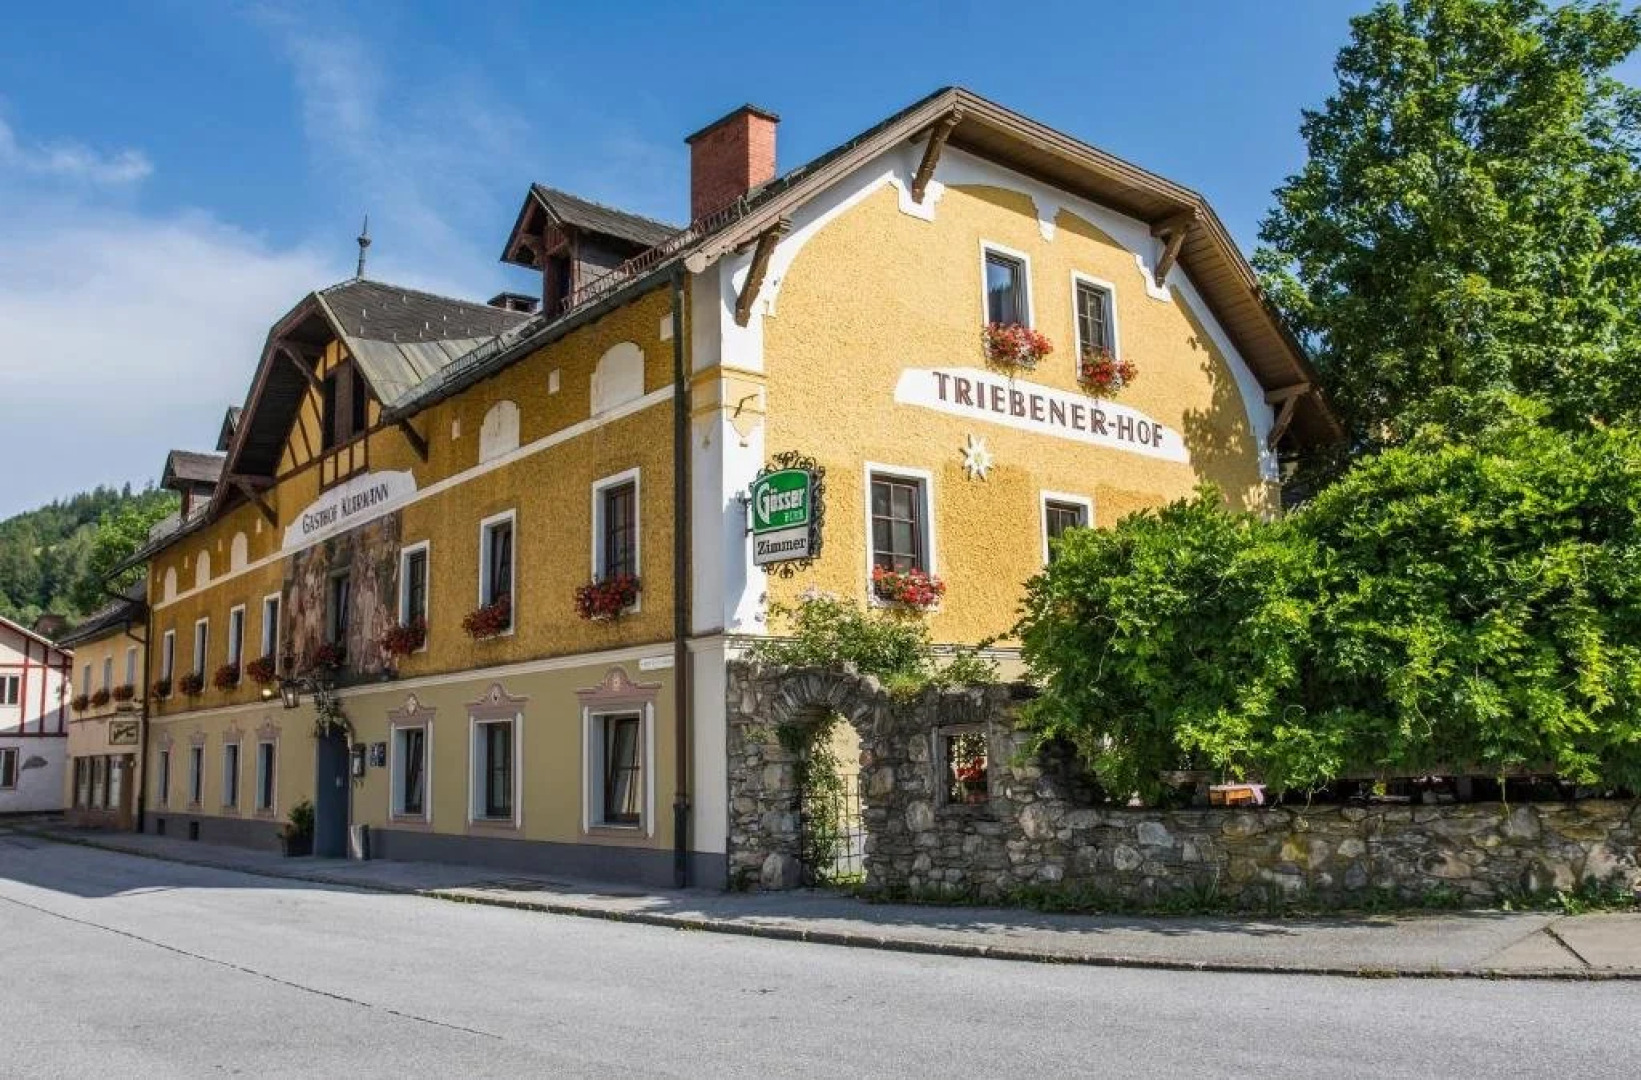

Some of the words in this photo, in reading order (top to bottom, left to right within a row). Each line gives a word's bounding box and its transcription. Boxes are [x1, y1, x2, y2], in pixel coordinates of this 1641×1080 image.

[932, 371, 1163, 448] TRIEBENER-HOF
[756, 482, 805, 525] Gösser
[757, 538, 806, 556] Zimmer
